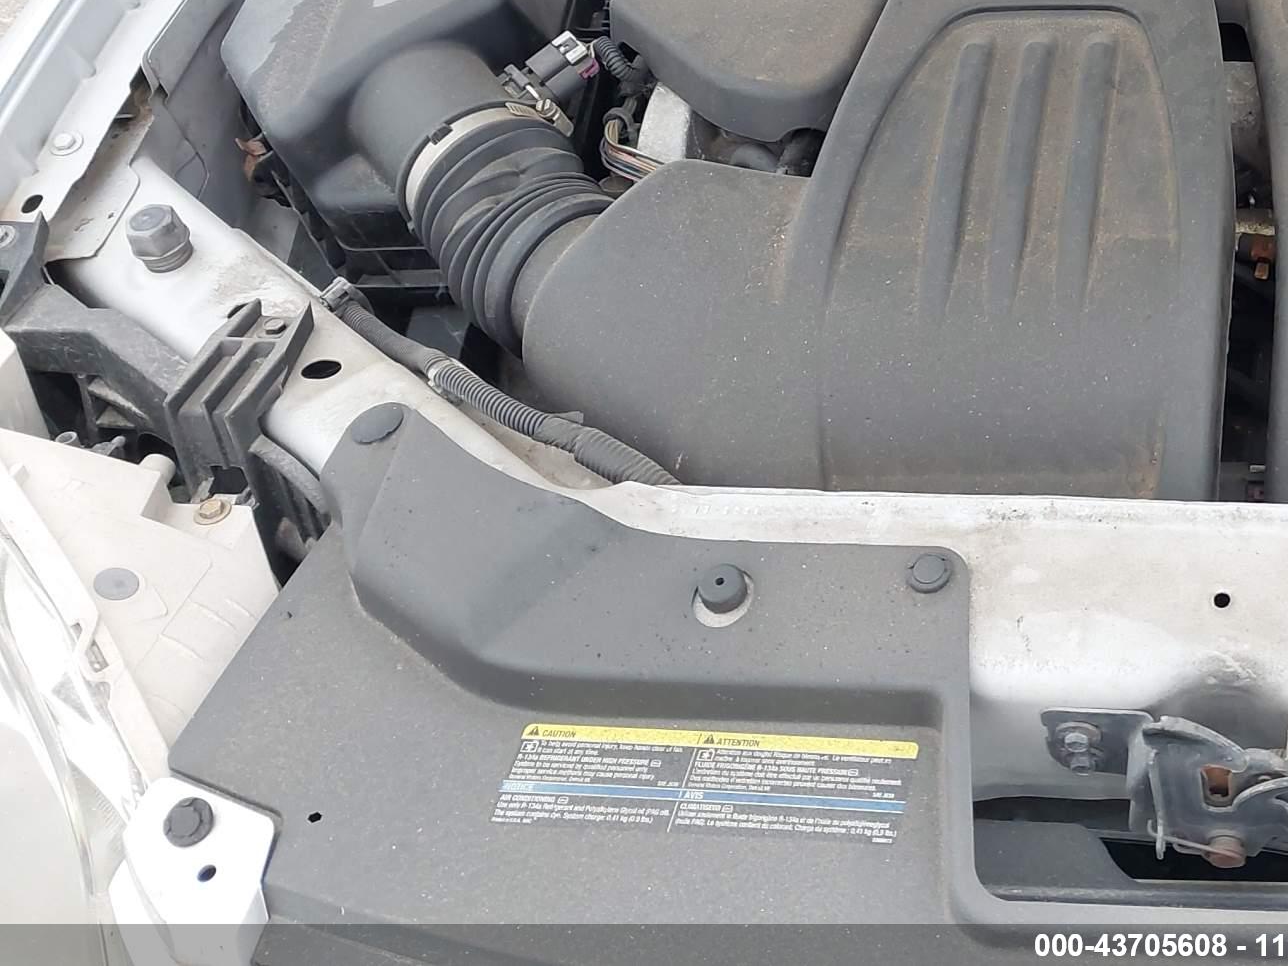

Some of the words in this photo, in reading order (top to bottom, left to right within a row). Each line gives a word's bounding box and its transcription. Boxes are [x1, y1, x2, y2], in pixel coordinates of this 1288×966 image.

[542, 729, 576, 738] CAUTION
[716, 738, 760, 747] ATTENTION
[684, 791, 704, 800] AVIS
